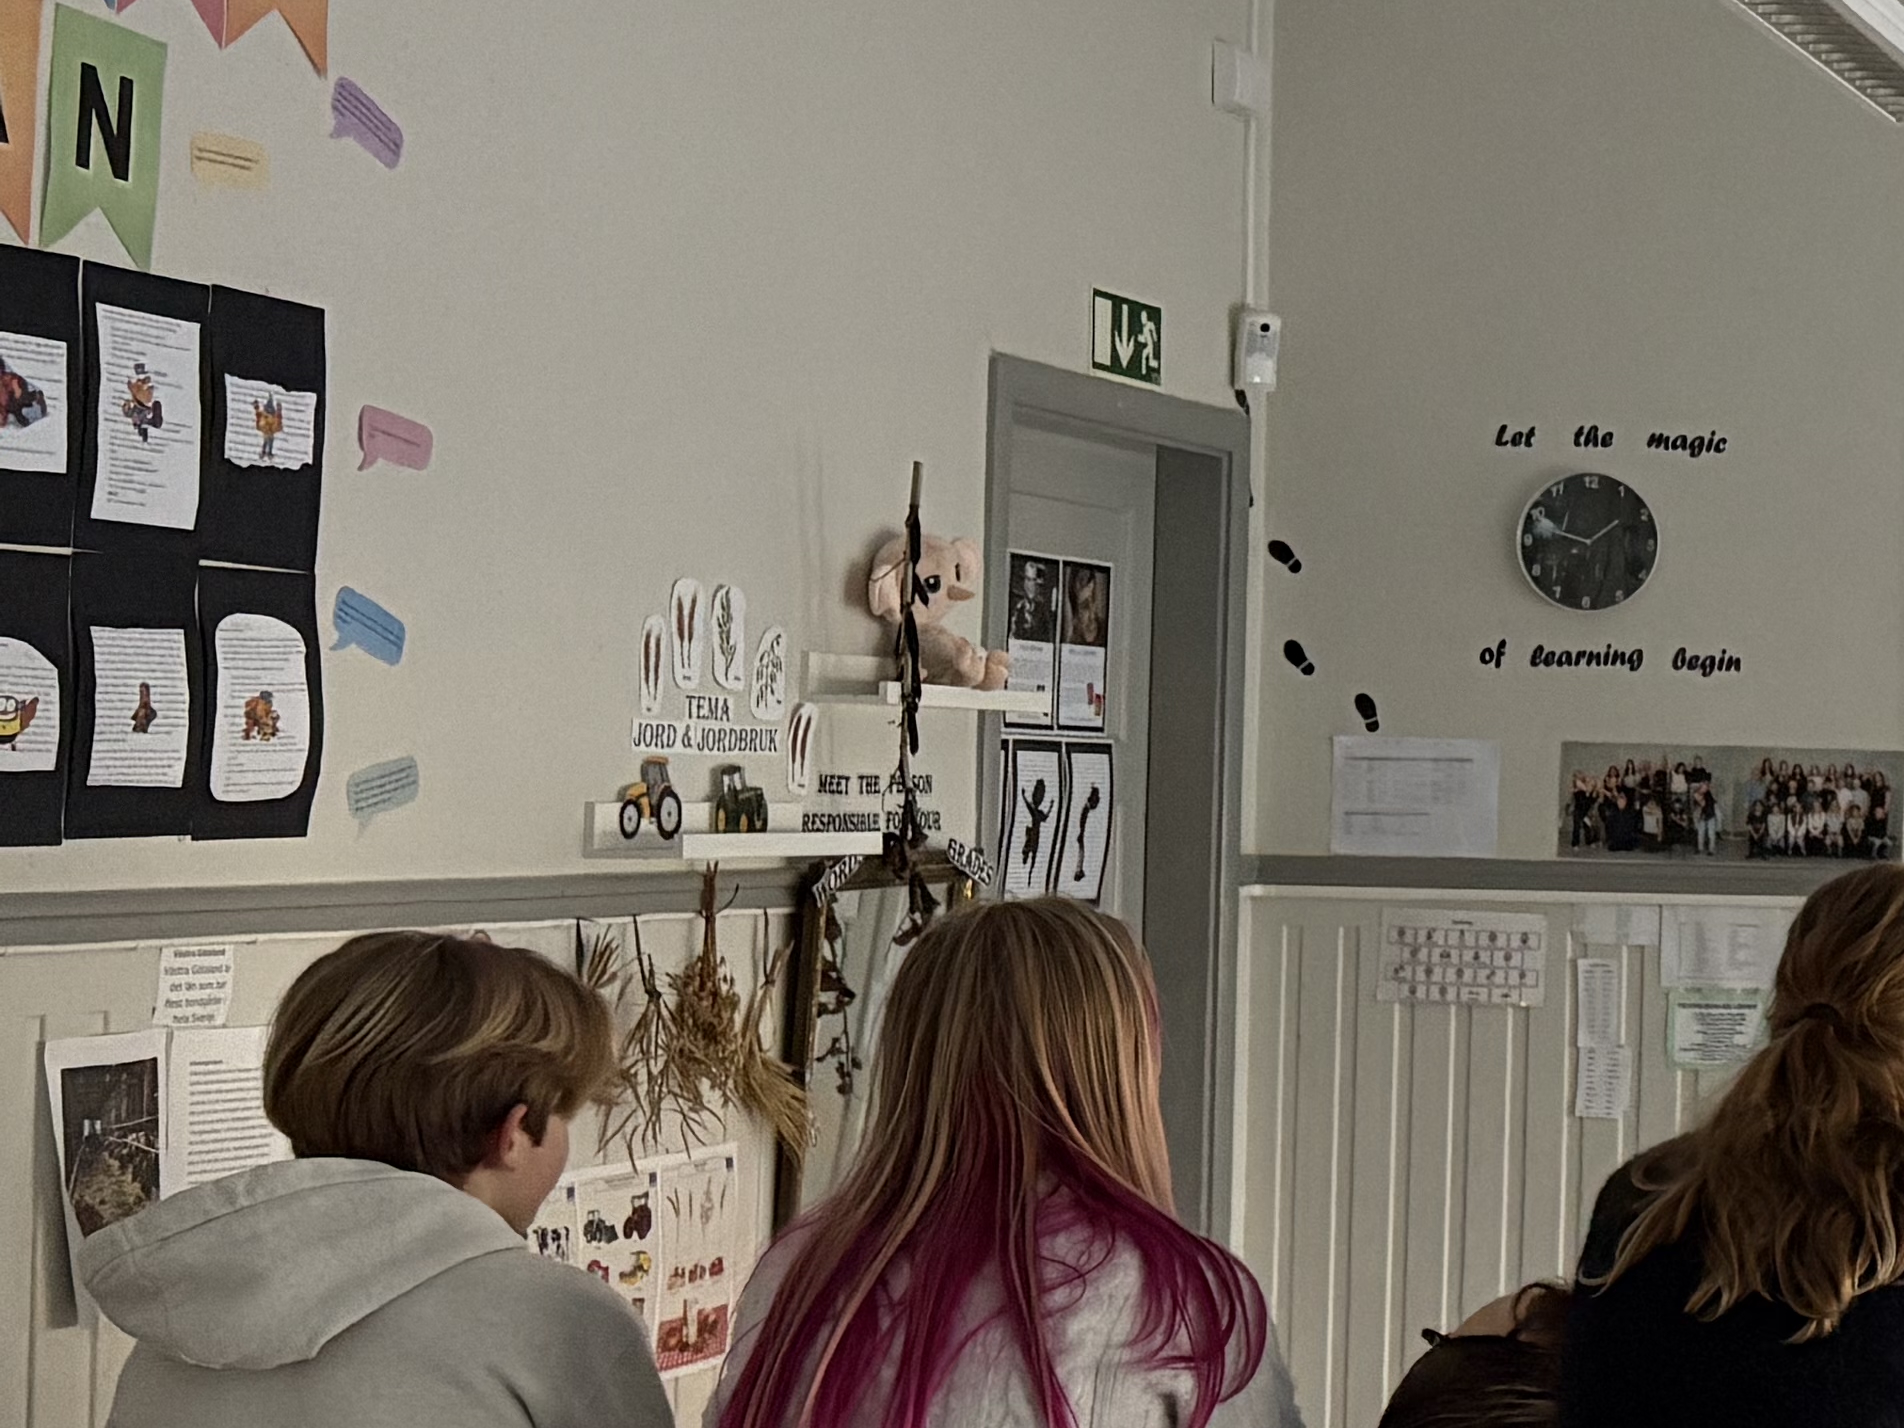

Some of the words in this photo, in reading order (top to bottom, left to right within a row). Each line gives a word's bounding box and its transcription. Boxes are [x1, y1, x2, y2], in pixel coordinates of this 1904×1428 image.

[1495, 424, 1536, 448] Let
[1573, 424, 1614, 448] the
[1647, 430, 1728, 458] magic
[1583, 476, 1600, 489] 12
[1530, 506, 1546, 520] 10
[1479, 638, 1507, 669] of
[1530, 643, 1644, 672] learning
[1672, 647, 1742, 678] begin
[685, 695, 731, 721] TEMA
[632, 722, 677, 749] JORD
[681, 724, 694, 749] &
[696, 725, 780, 754] JORDBRUK
[818, 774, 851, 795] MEET
[858, 774, 881, 795] THE
[888, 773, 933, 795] PESON
[802, 812, 881, 833] RESPONSIBLE
